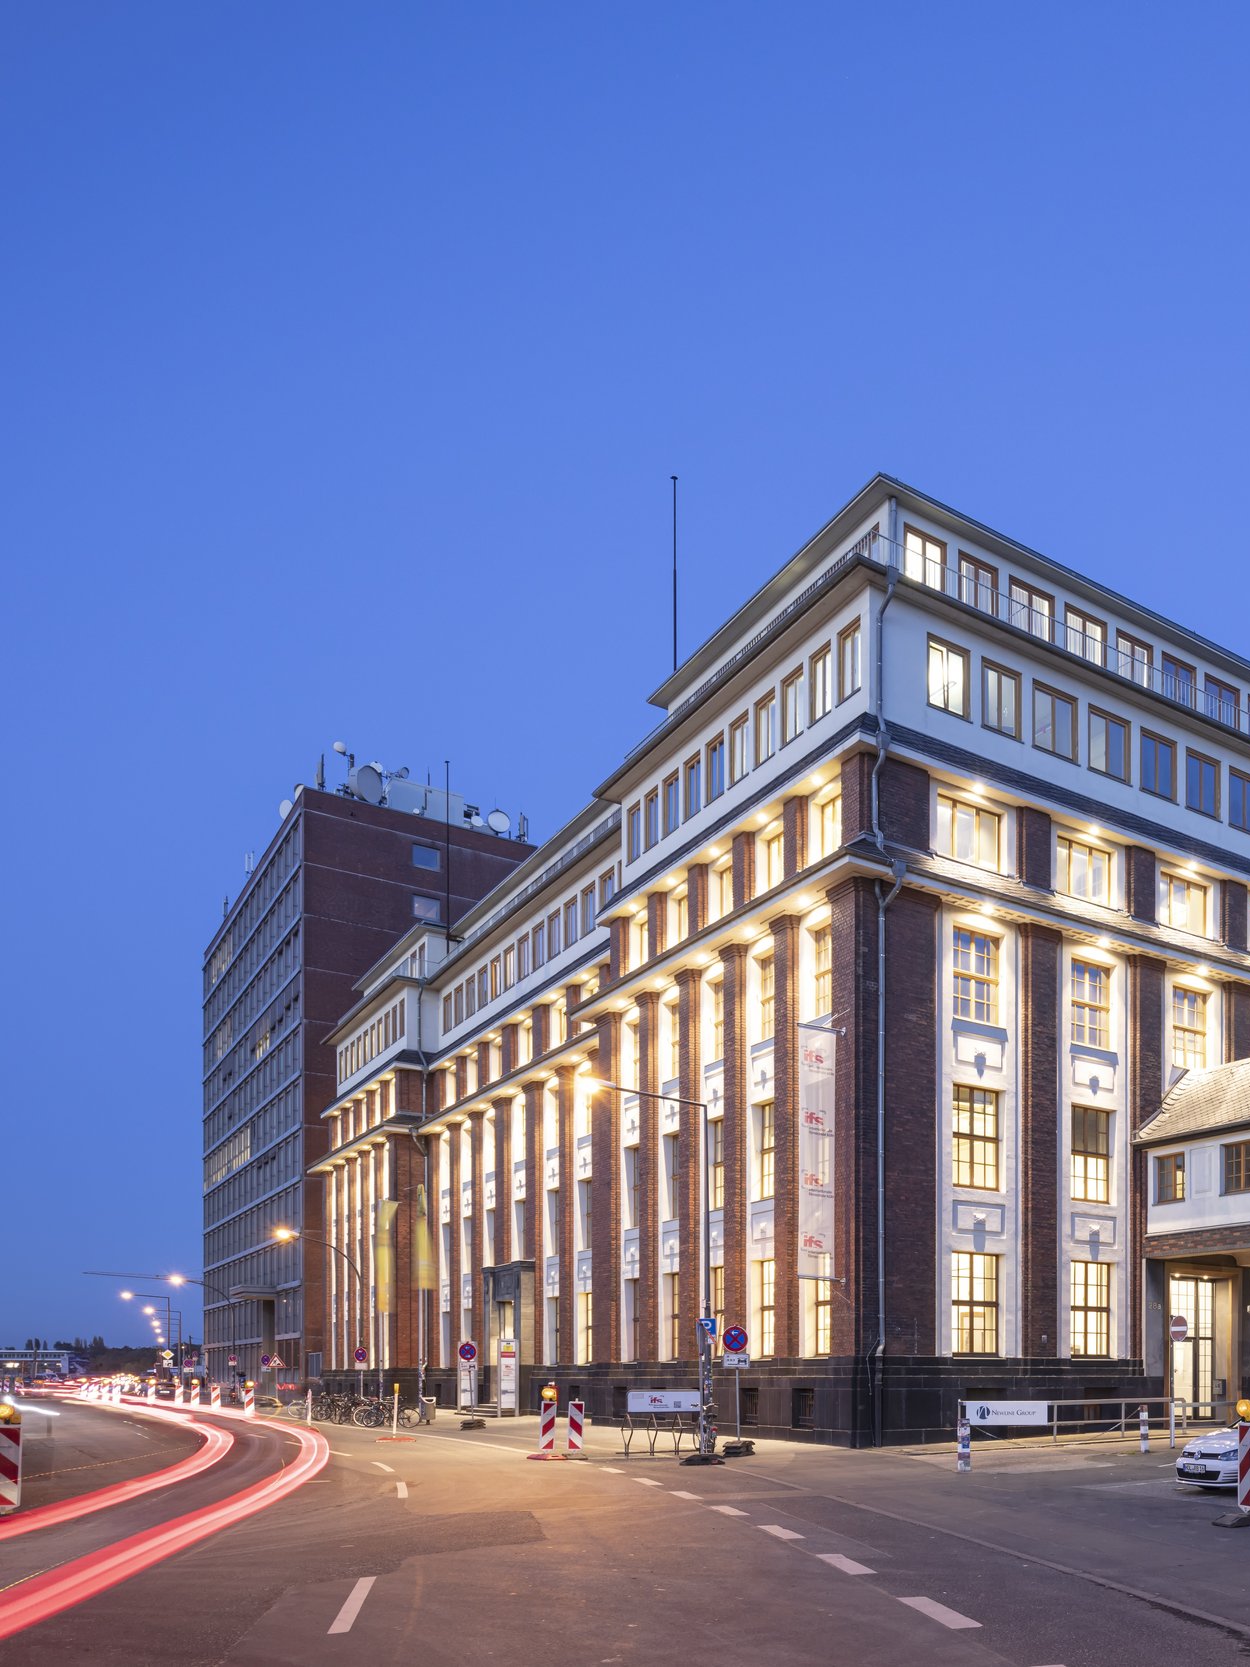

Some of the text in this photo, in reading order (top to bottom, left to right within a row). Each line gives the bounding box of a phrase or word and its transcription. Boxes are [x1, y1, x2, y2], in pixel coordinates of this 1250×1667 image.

[804, 1049, 824, 1064] ifs
[804, 1111, 824, 1126] ifs
[804, 1173, 824, 1187] ifs
[803, 1234, 823, 1249] ifs
